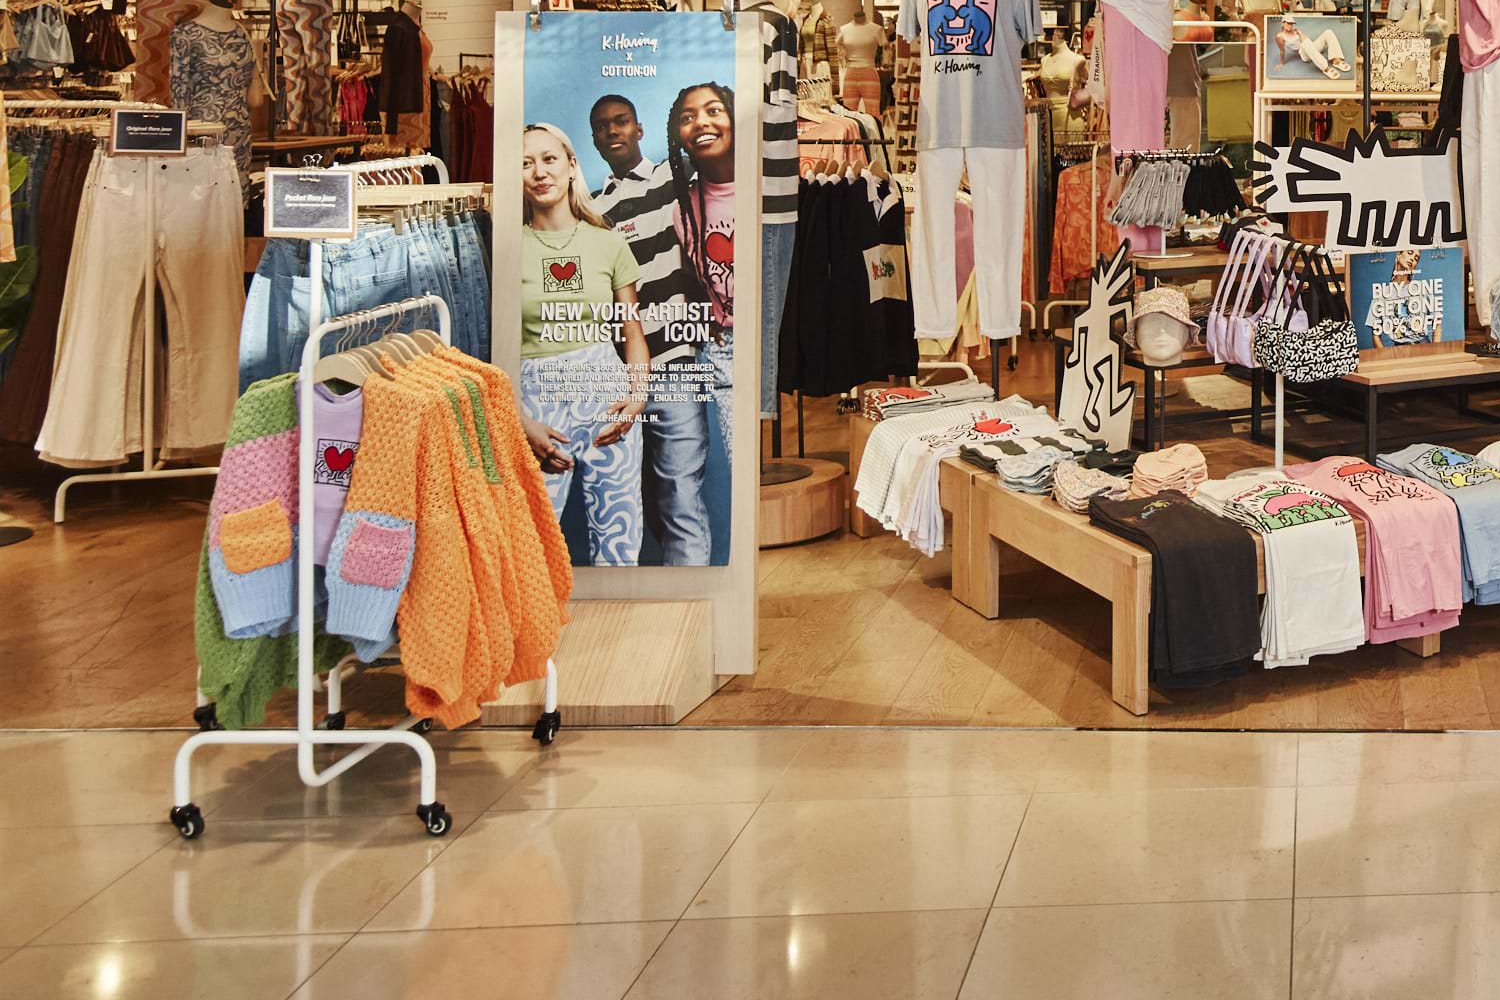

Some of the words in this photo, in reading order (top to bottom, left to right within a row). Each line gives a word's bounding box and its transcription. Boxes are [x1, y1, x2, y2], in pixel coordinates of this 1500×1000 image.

[602, 65, 657, 77] COTTON:ON
[1372, 282, 1406, 299] BUY
[1408, 278, 1443, 297] ONE
[541, 302, 583, 321] NEW
[590, 302, 640, 321] YORK
[645, 302, 716, 321] ARTIST.
[1372, 299, 1408, 318] GET
[1408, 296, 1443, 315] ONE
[1373, 317, 1407, 336] 50%
[1410, 313, 1443, 332] OFF
[539, 323, 627, 342] ACTIVIST.
[664, 323, 716, 342] ICON.
[634, 363, 649, 372] ART
[651, 363, 666, 372] HAS
[669, 363, 714, 372] INFLUENCED
[539, 374, 553, 383] THE
[602, 374, 637, 383] INSPIRED
[639, 374, 667, 383] PEOPLE
[669, 374, 679, 383] TO
[681, 374, 714, 383] EXPRESS
[616, 384, 632, 392] OUR
[636, 384, 665, 392] COLLAB
[669, 384, 677, 392] IS
[681, 384, 701, 392] HERE
[704, 384, 714, 392] TO
[581, 394, 591, 402] TO
[595, 394, 628, 402] SPREAD
[631, 394, 649, 402] THAT
[654, 394, 688, 402] ENDLESS
[693, 394, 715, 402] LOVE.
[635, 414, 649, 423] ALL
[650, 414, 661, 423] IN.
